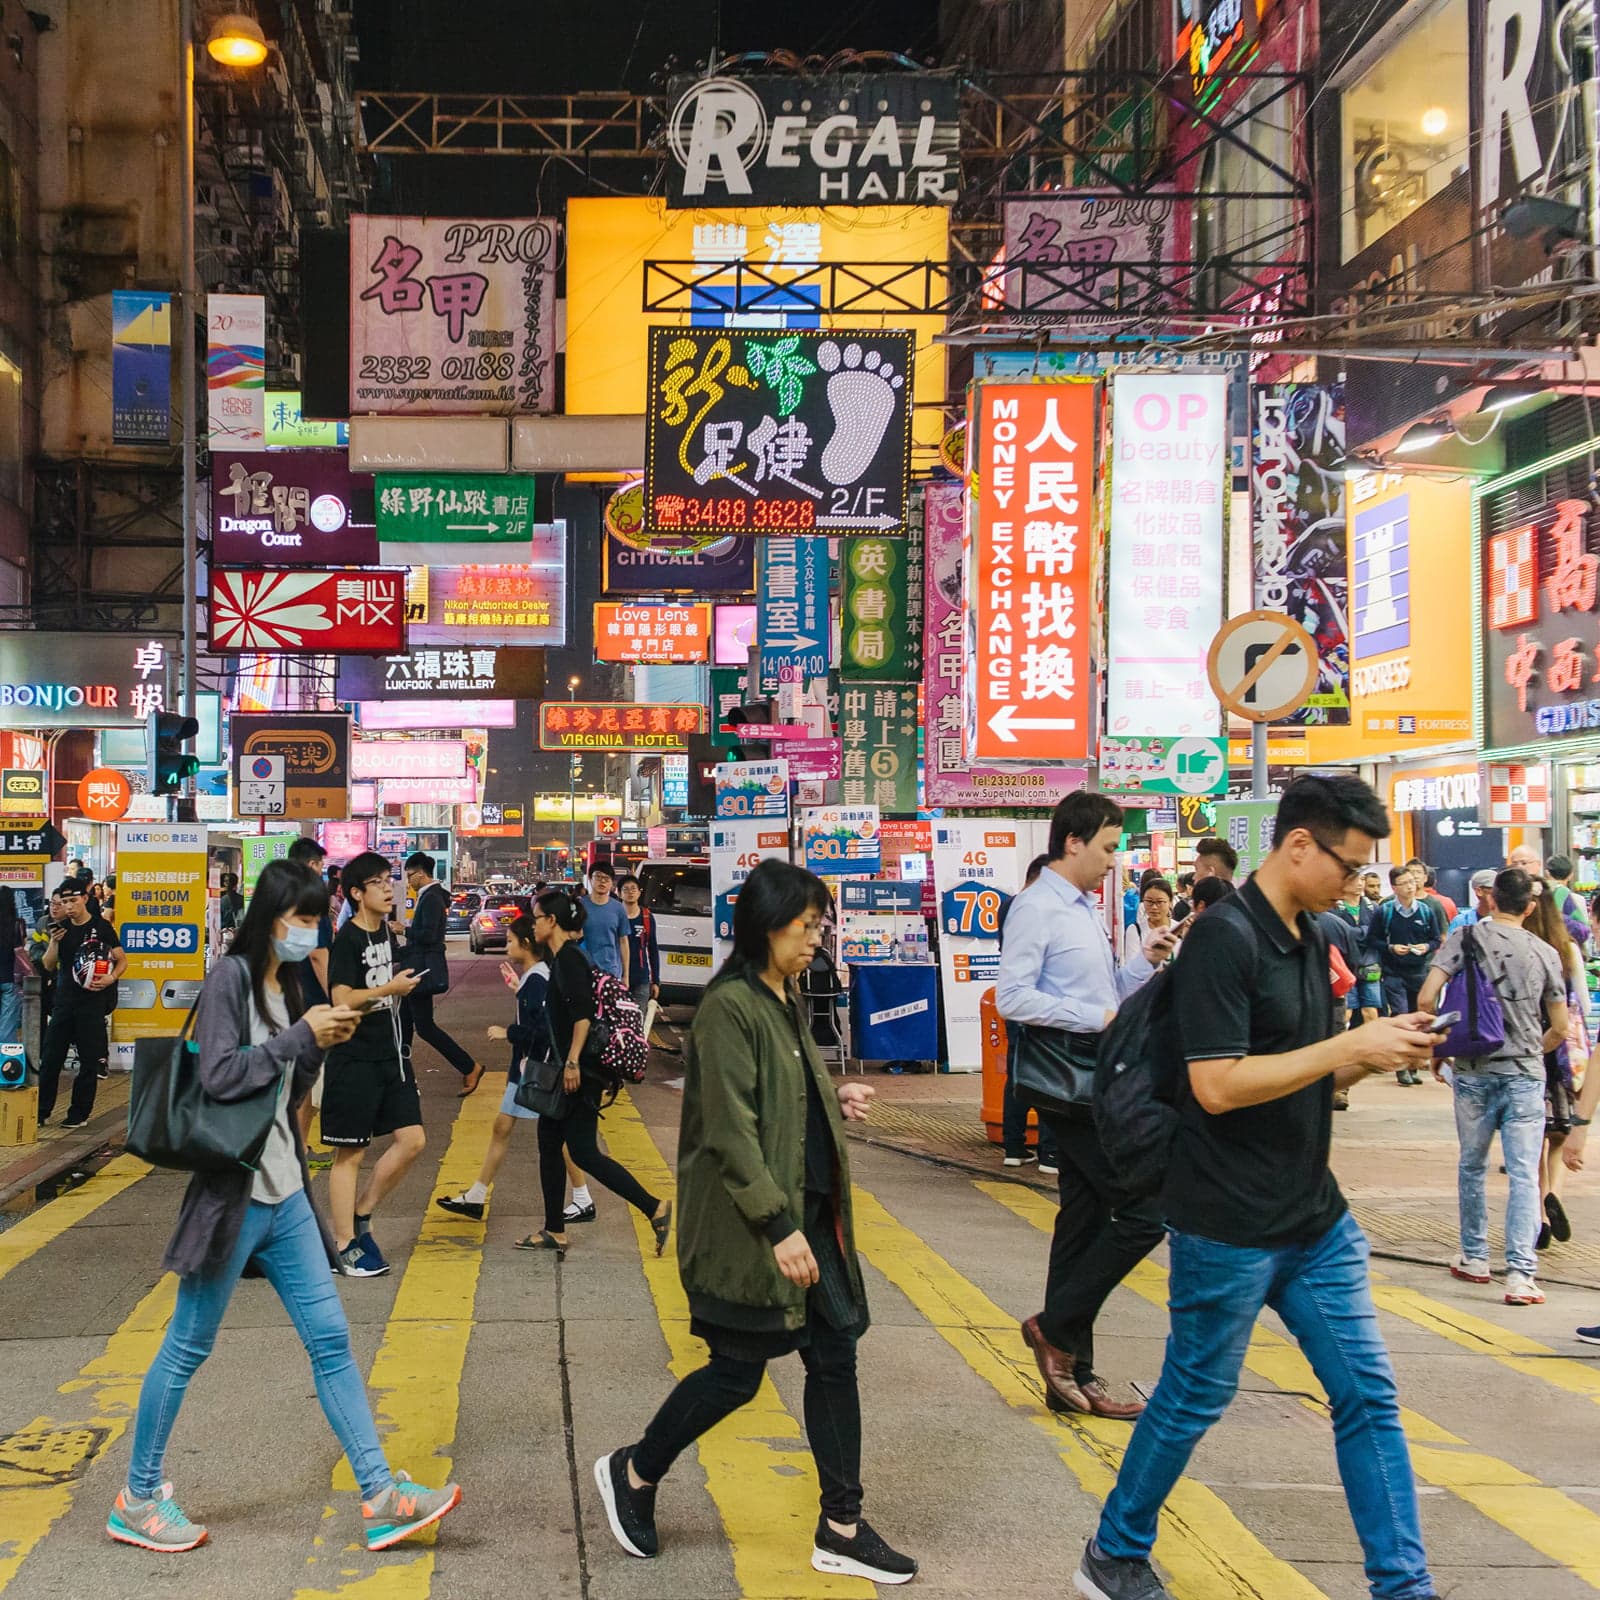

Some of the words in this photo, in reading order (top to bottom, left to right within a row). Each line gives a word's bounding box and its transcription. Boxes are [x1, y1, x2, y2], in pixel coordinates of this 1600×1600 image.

[683, 91, 948, 195] REGAL
[820, 171, 959, 200] HAIR
[445, 223, 551, 264] PRO
[359, 236, 489, 343] 名甲
[359, 356, 430, 384] 2332
[441, 352, 515, 381] 0188
[1133, 393, 1209, 432] OP
[992, 399, 1019, 509] MONEY
[1120, 437, 1220, 466] beauty
[830, 488, 886, 515] 2/F
[685, 499, 746, 527] 3488
[752, 501, 814, 528] 3628
[220, 516, 272, 533] Dragon
[506, 521, 527, 534] 2/F
[261, 531, 302, 546] Court
[1020, 398, 1079, 700] 人民幣找換
[336, 579, 395, 602] 美心
[444, 600, 469, 610] Nikon
[472, 600, 519, 610] Authorized
[522, 600, 550, 610] Dealer
[988, 522, 1015, 700] EXCHANGE
[336, 603, 394, 625] MX
[615, 608, 650, 621] Love
[657, 608, 689, 621] Lens
[631, 638, 675, 652] 專門店
[386, 650, 496, 679] 六福珠寶
[385, 680, 433, 690] LUKFOOK
[436, 679, 496, 690] JEWELLERY
[0, 685, 118, 710] BONJOUR
[1418, 719, 1470, 730] FORTRESS
[561, 734, 624, 746] VIRGINIA
[634, 734, 683, 746] HOTEL
[1266, 748, 1305, 757] ORTRESS
[733, 767, 748, 776] 4G
[1020, 775, 1045, 787] 0188
[268, 784, 276, 795] 7
[88, 796, 120, 808] MX
[268, 802, 282, 813] 12
[822, 812, 838, 821] 4G
[737, 853, 760, 867] 4G
[963, 851, 988, 865] 4G
[145, 927, 192, 949] $98
[671, 954, 684, 964] UG
[686, 955, 709, 965] 5381
